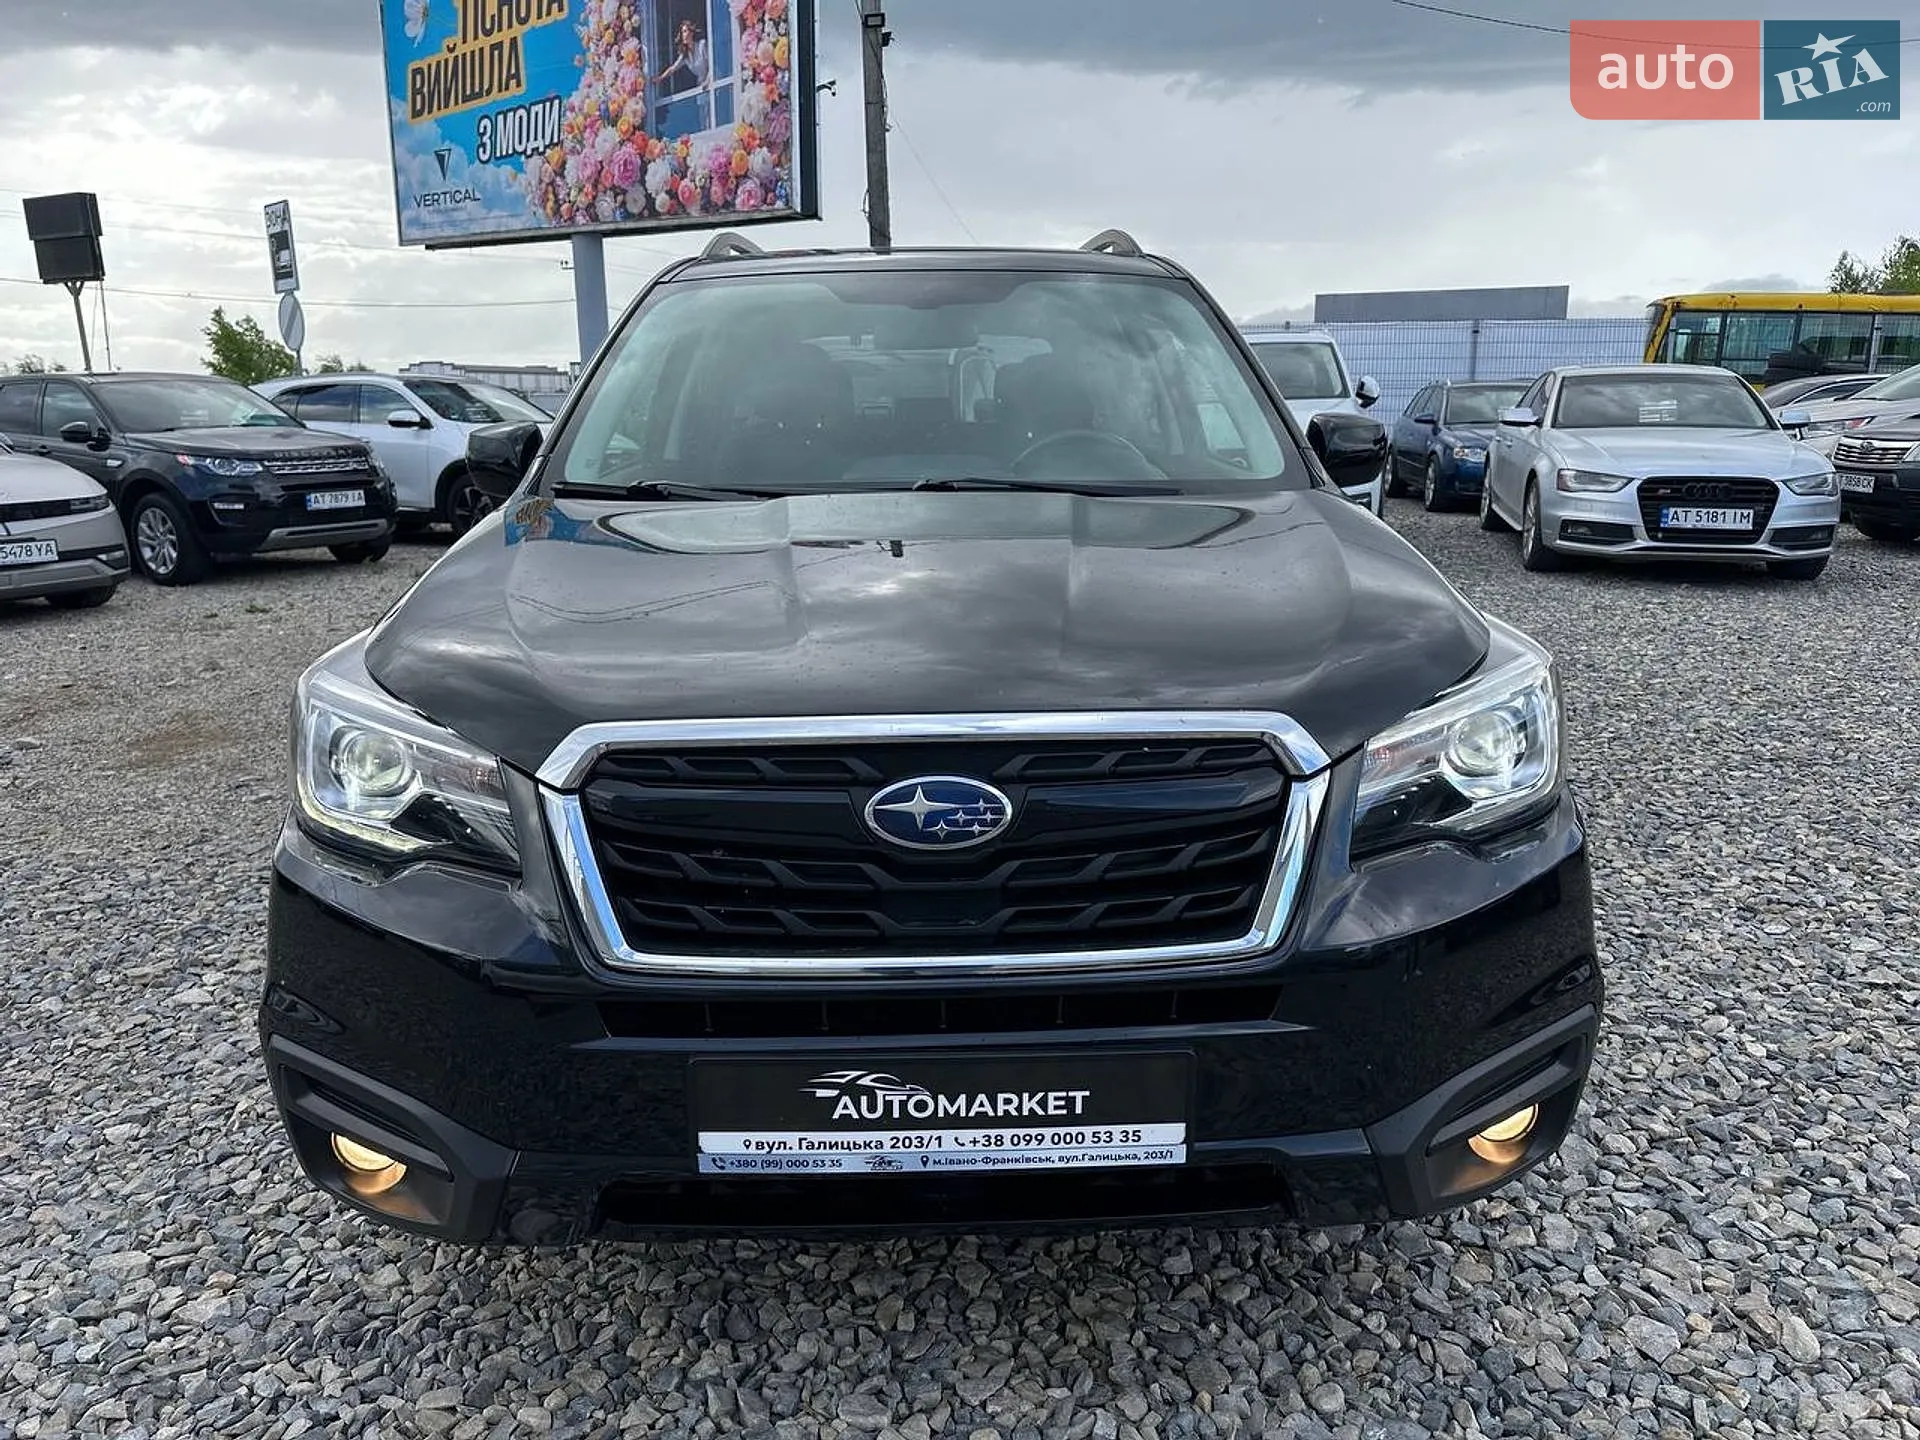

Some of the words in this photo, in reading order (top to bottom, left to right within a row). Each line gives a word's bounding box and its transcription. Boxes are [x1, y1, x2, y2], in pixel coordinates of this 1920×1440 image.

[411, 36, 522, 120] ВИЙШЛА
[495, 98, 562, 158] МОДИ
[413, 187, 481, 208] VERTICAL
[1671, 509, 1691, 523] AT
[1695, 510, 1726, 524] 5181
[1732, 510, 1750, 524] IM
[0, 544, 33, 559] 5478
[35, 543, 54, 556] YA
[832, 1090, 1090, 1119] AUTOMARKET
[755, 1140, 793, 1155] вул.
[798, 1137, 884, 1152] Галицька
[889, 1135, 942, 1149] 203/1
[969, 1134, 1005, 1148] +38
[1010, 1133, 1045, 1146] 099
[1051, 1132, 1086, 1145] 000
[1091, 1130, 1114, 1144] 53
[1119, 1129, 1142, 1143] 35
[729, 1159, 758, 1169] +380
[760, 1158, 783, 1170] (99)
[785, 1159, 810, 1169] 000
[812, 1159, 827, 1168] 53
[828, 1158, 843, 1168] 35
[1143, 1149, 1174, 1161] 203/1
